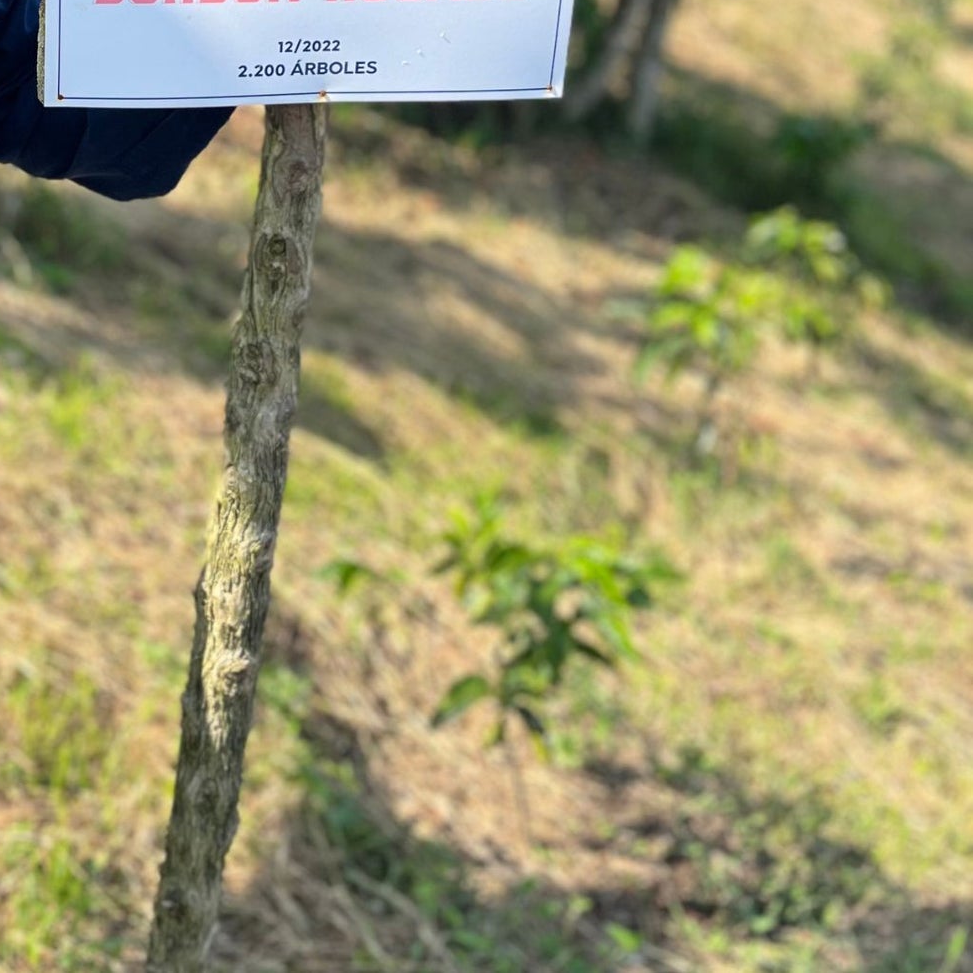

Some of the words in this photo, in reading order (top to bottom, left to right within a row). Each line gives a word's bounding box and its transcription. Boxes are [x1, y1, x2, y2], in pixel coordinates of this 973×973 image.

[278, 39, 341, 54] 12/2022
[238, 64, 285, 78] 2.200
[290, 60, 378, 76] ÁRBOLES
